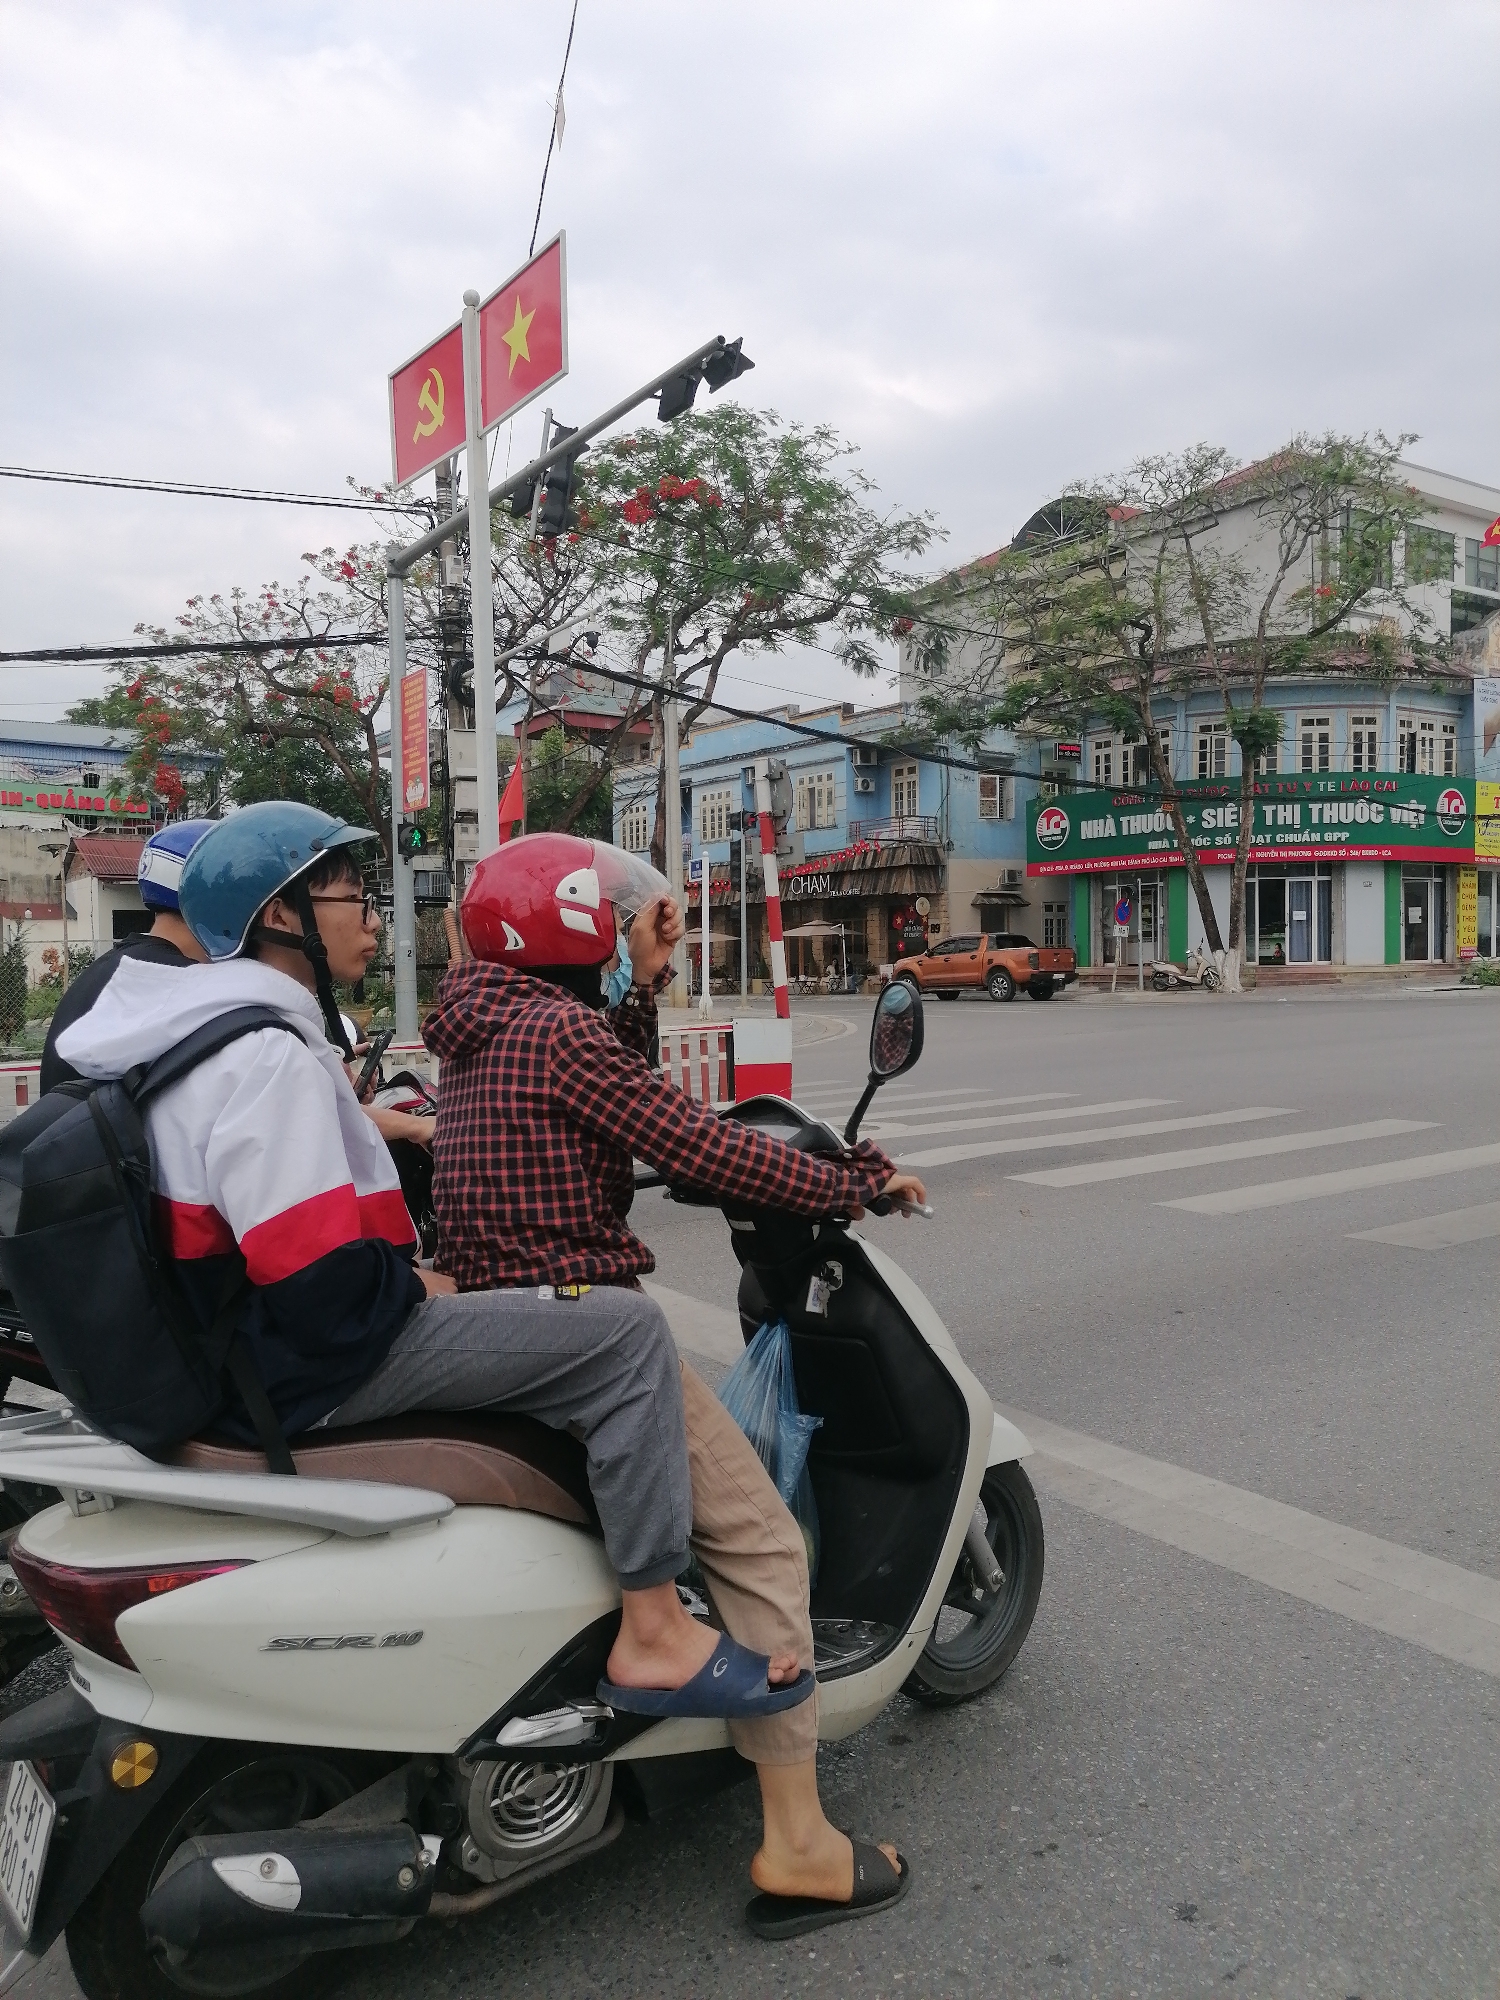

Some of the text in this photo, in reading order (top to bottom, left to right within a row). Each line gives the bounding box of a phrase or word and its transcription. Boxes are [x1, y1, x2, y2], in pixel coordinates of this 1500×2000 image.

[1303, 781, 1313, 792] Y
[1374, 780, 1398, 792] CAI
[36, 788, 106, 811] QUẢNG
[1081, 814, 1117, 839] NHÀ
[1263, 804, 1301, 829] THỊ
[1309, 797, 1384, 824] THUỐC
[1390, 800, 1426, 829] VIỆT
[1148, 838, 1170, 850] NHÀ
[1214, 832, 1232, 846] SỐ
[1276, 829, 1321, 844] CHUẨN
[1324, 831, 1350, 843] GPP
[791, 875, 830, 896] CHẠM
[1462, 915, 1476, 923] THEO
[407, 949, 412, 958] 2
[259, 1629, 424, 1651] SCR 110
